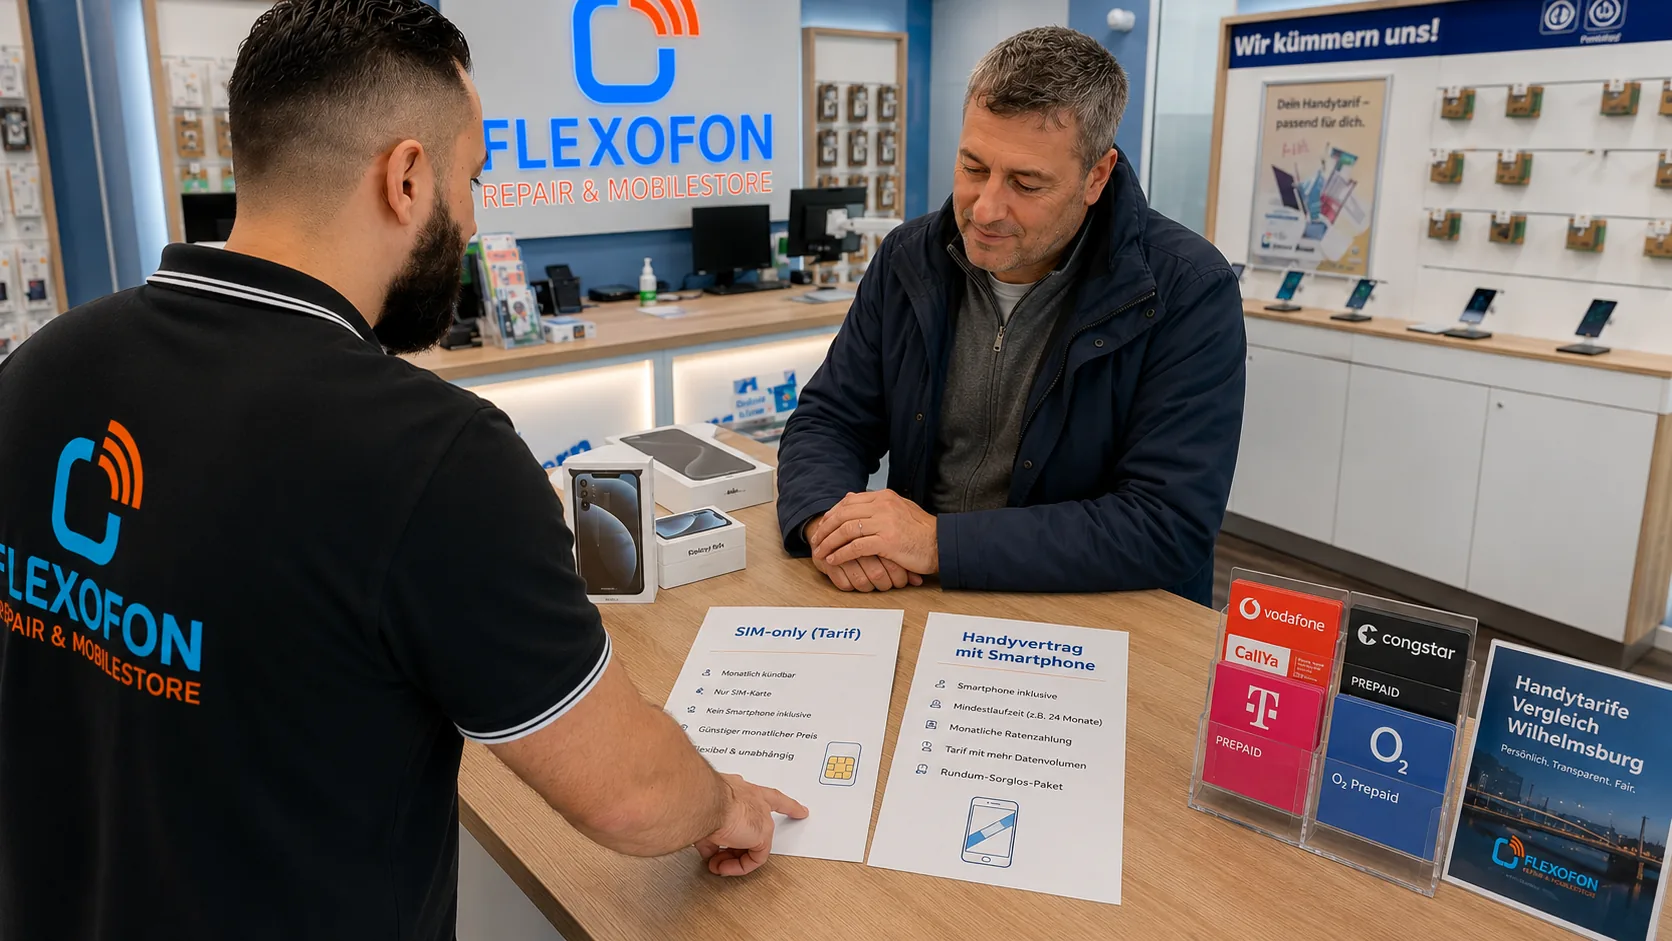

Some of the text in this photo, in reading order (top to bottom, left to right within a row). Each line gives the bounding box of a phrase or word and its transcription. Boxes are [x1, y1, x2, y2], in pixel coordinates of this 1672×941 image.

[1234, 17, 1440, 56] Wir kümmern uns!
[1277, 98, 1300, 110] Dein
[1303, 96, 1361, 111] Handytarif
[1276, 115, 1365, 130] passend für dich.
[483, 114, 772, 170] FLEXOFON
[482, 171, 772, 208] REPAIR & MOBILESTORE
[1264, 607, 1326, 632] vodafone
[734, 626, 862, 641] SIM-only (Tarif)
[962, 631, 1084, 656] Handyvertrag
[1235, 644, 1279, 668] CallYa
[1382, 632, 1456, 661] congstar
[51, 625, 66, 648] &
[73, 631, 201, 705] MOBILESTORE
[955, 647, 1096, 672] mit Smartphone
[721, 670, 796, 679] Monatlich kündbar
[1351, 676, 1400, 698] PREPAID
[714, 688, 772, 698] Nur SIM-Karte
[957, 682, 1058, 700] Smartphone inklusive
[1515, 674, 1630, 720] Handytarife
[726, 708, 776, 718] Smartphone
[776, 710, 812, 718] inklusive
[953, 703, 1103, 728] Mindestlaufzeit (z.B. 24 Monate)
[1512, 696, 1600, 734] Vergleich
[698, 726, 818, 740] Günstiger monatlicher Preis
[949, 724, 1072, 747] Monatliche Ratenzahlung
[729, 747, 736, 755] &
[738, 750, 795, 761] unabhängig
[946, 745, 1087, 770] Tarif mit mehr Datenvolumen
[1216, 735, 1262, 758] PREPAID
[1507, 717, 1644, 776] Wilhelmsburg
[940, 768, 1064, 791] Rundum-Sorglos-Paket
[1500, 744, 1636, 794] Persönlich. Transparent. Fair.
[1350, 778, 1400, 804] Prepaid
[1524, 854, 1599, 892] FLEXOFON
